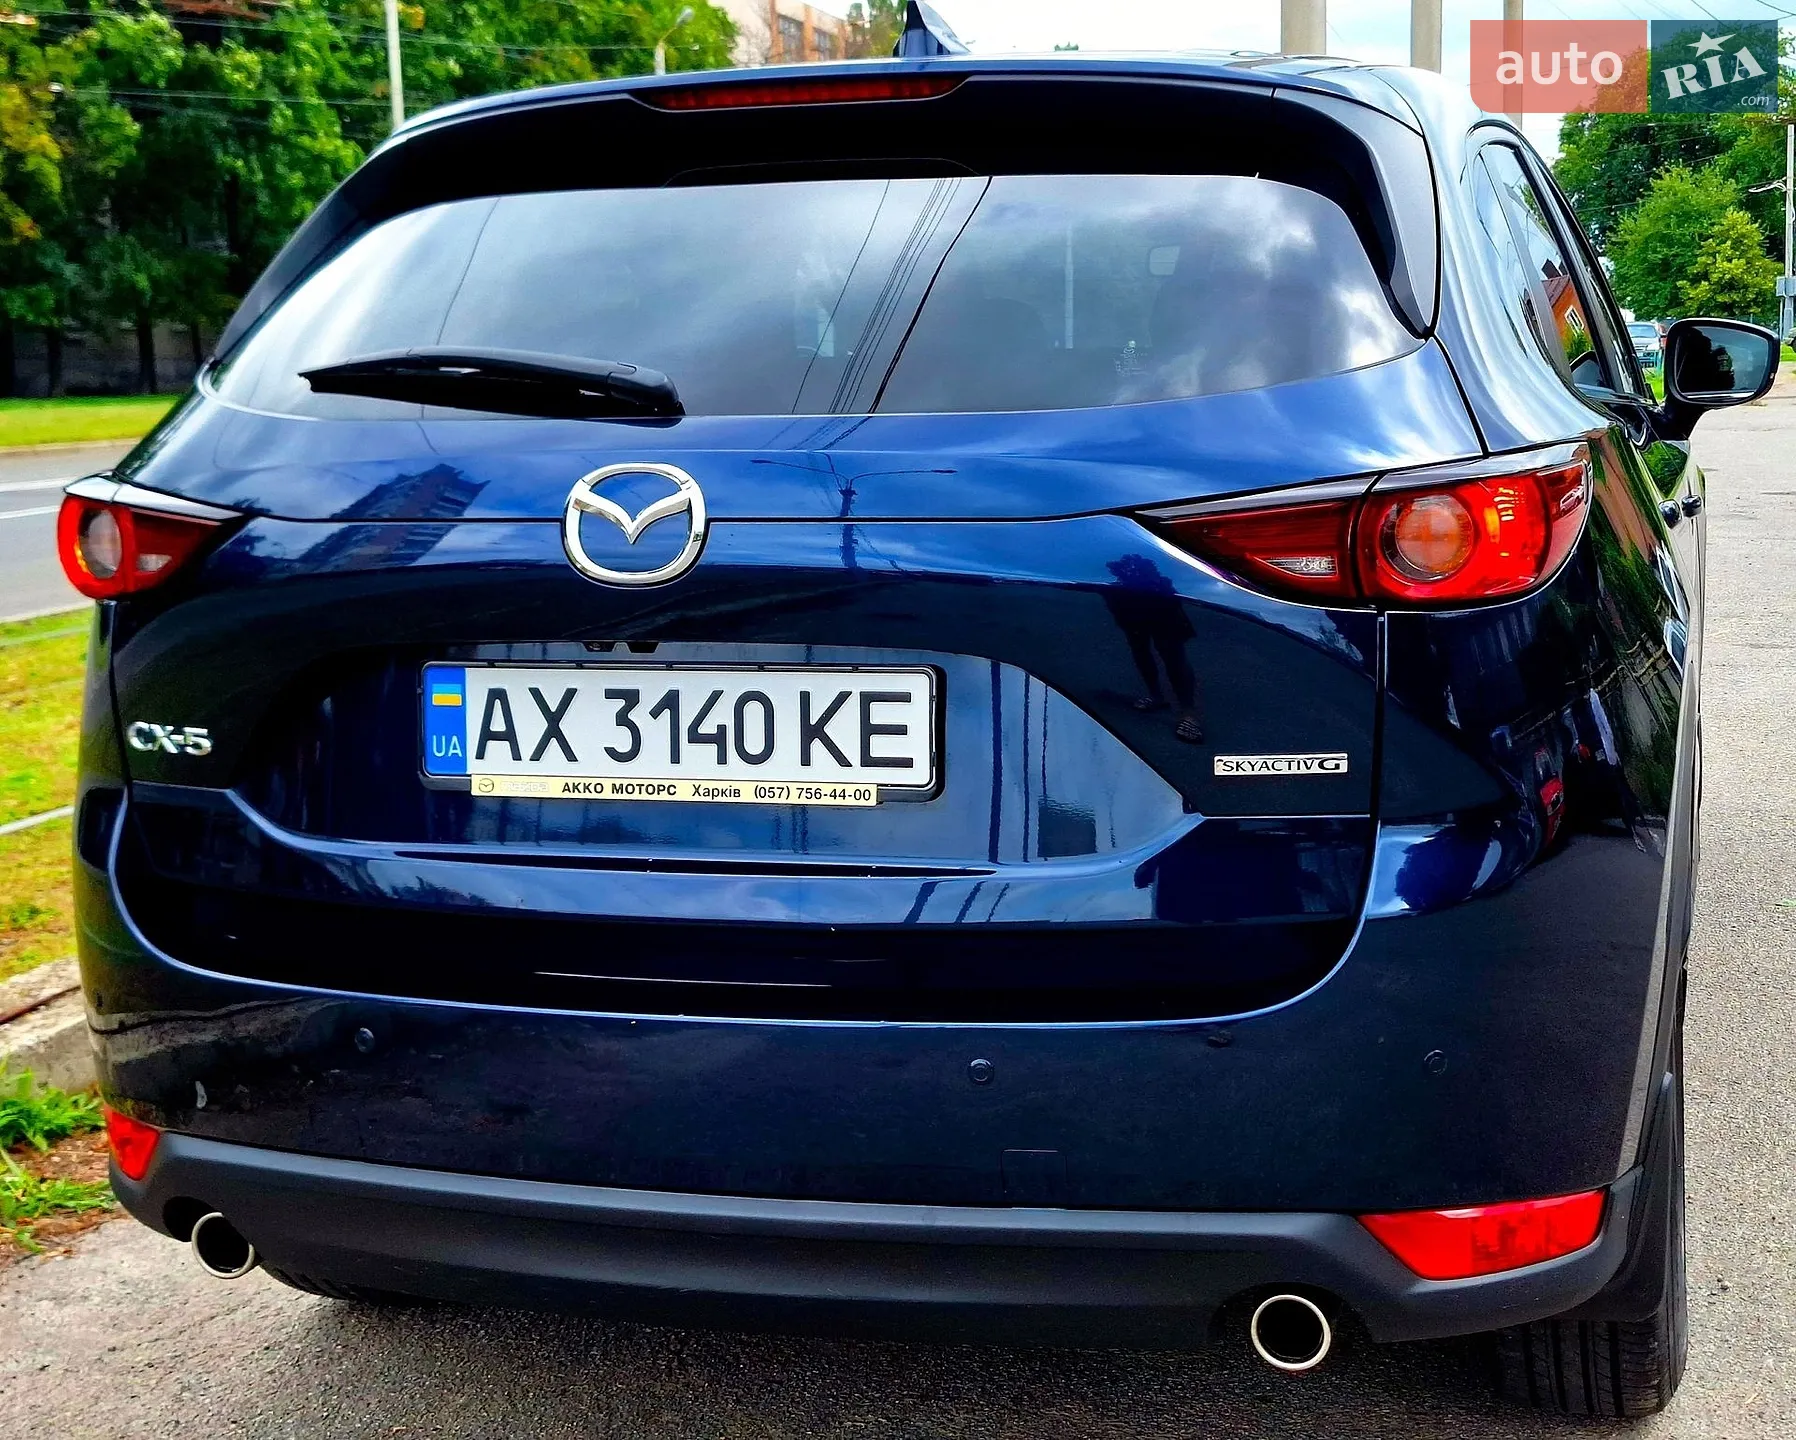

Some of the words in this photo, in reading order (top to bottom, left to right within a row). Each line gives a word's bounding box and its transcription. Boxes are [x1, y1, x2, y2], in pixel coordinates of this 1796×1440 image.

[127, 721, 213, 756] CX-5
[475, 687, 579, 762] AX
[603, 688, 775, 765] 3140
[799, 690, 914, 768] KE
[433, 734, 463, 757] UA
[561, 782, 604, 794] АККО
[611, 783, 677, 796] МОТОРС
[691, 784, 741, 799] Харків
[754, 785, 791, 800] (057)
[796, 787, 872, 801] 756-44-00
